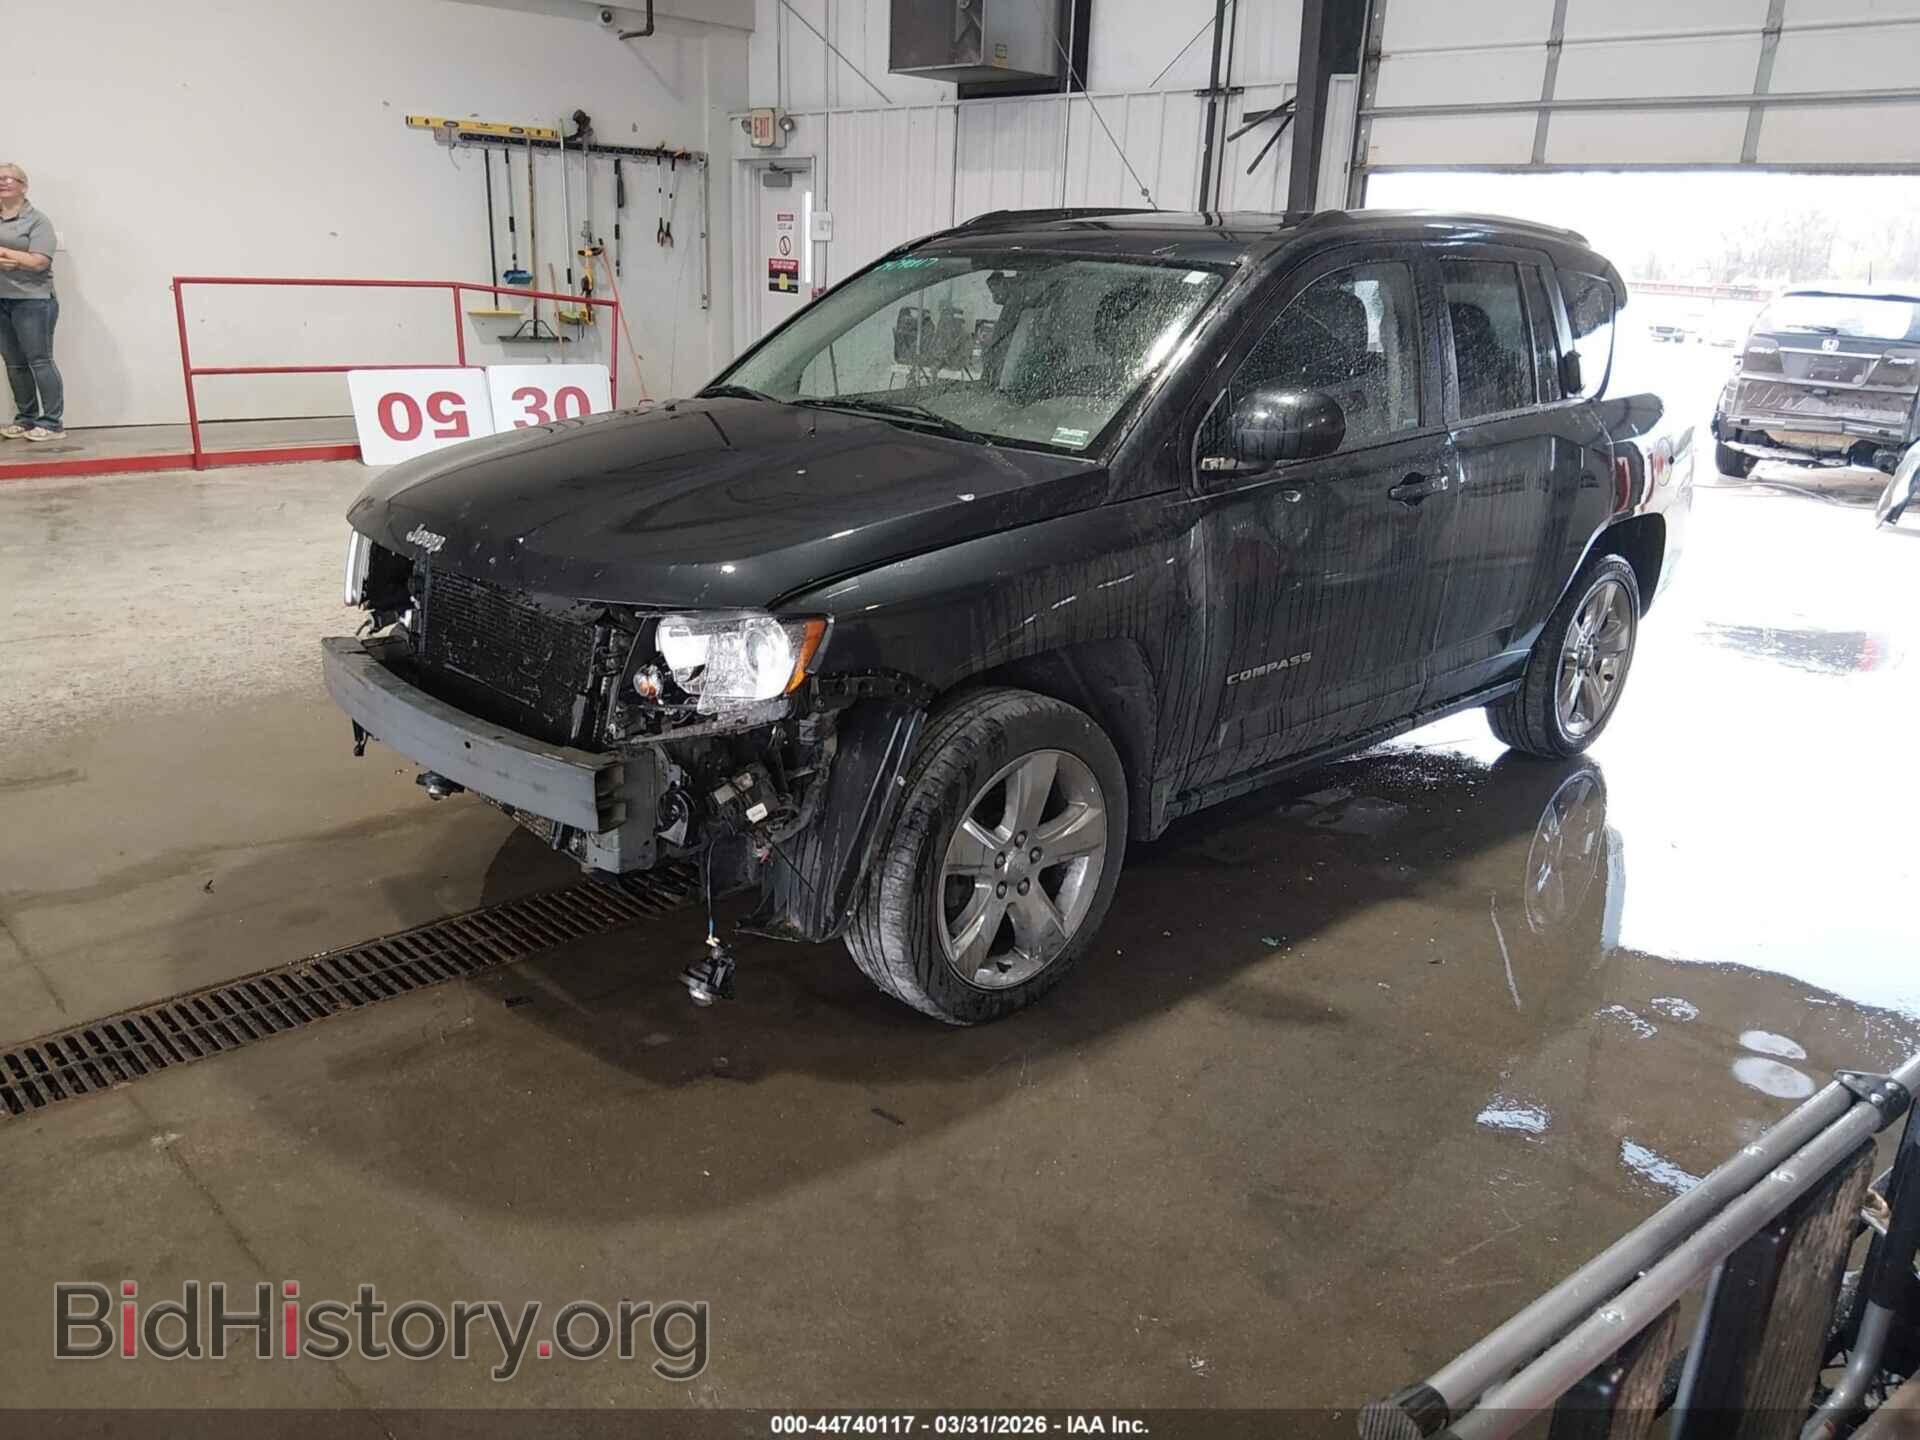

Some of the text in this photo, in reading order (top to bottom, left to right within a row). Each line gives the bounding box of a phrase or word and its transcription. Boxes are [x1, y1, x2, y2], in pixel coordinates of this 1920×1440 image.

[754, 117, 769, 138] EXIT
[377, 391, 470, 441] 50
[511, 386, 592, 428] 30
[406, 523, 446, 554] Jeep
[1226, 651, 1312, 685] COMPASS
